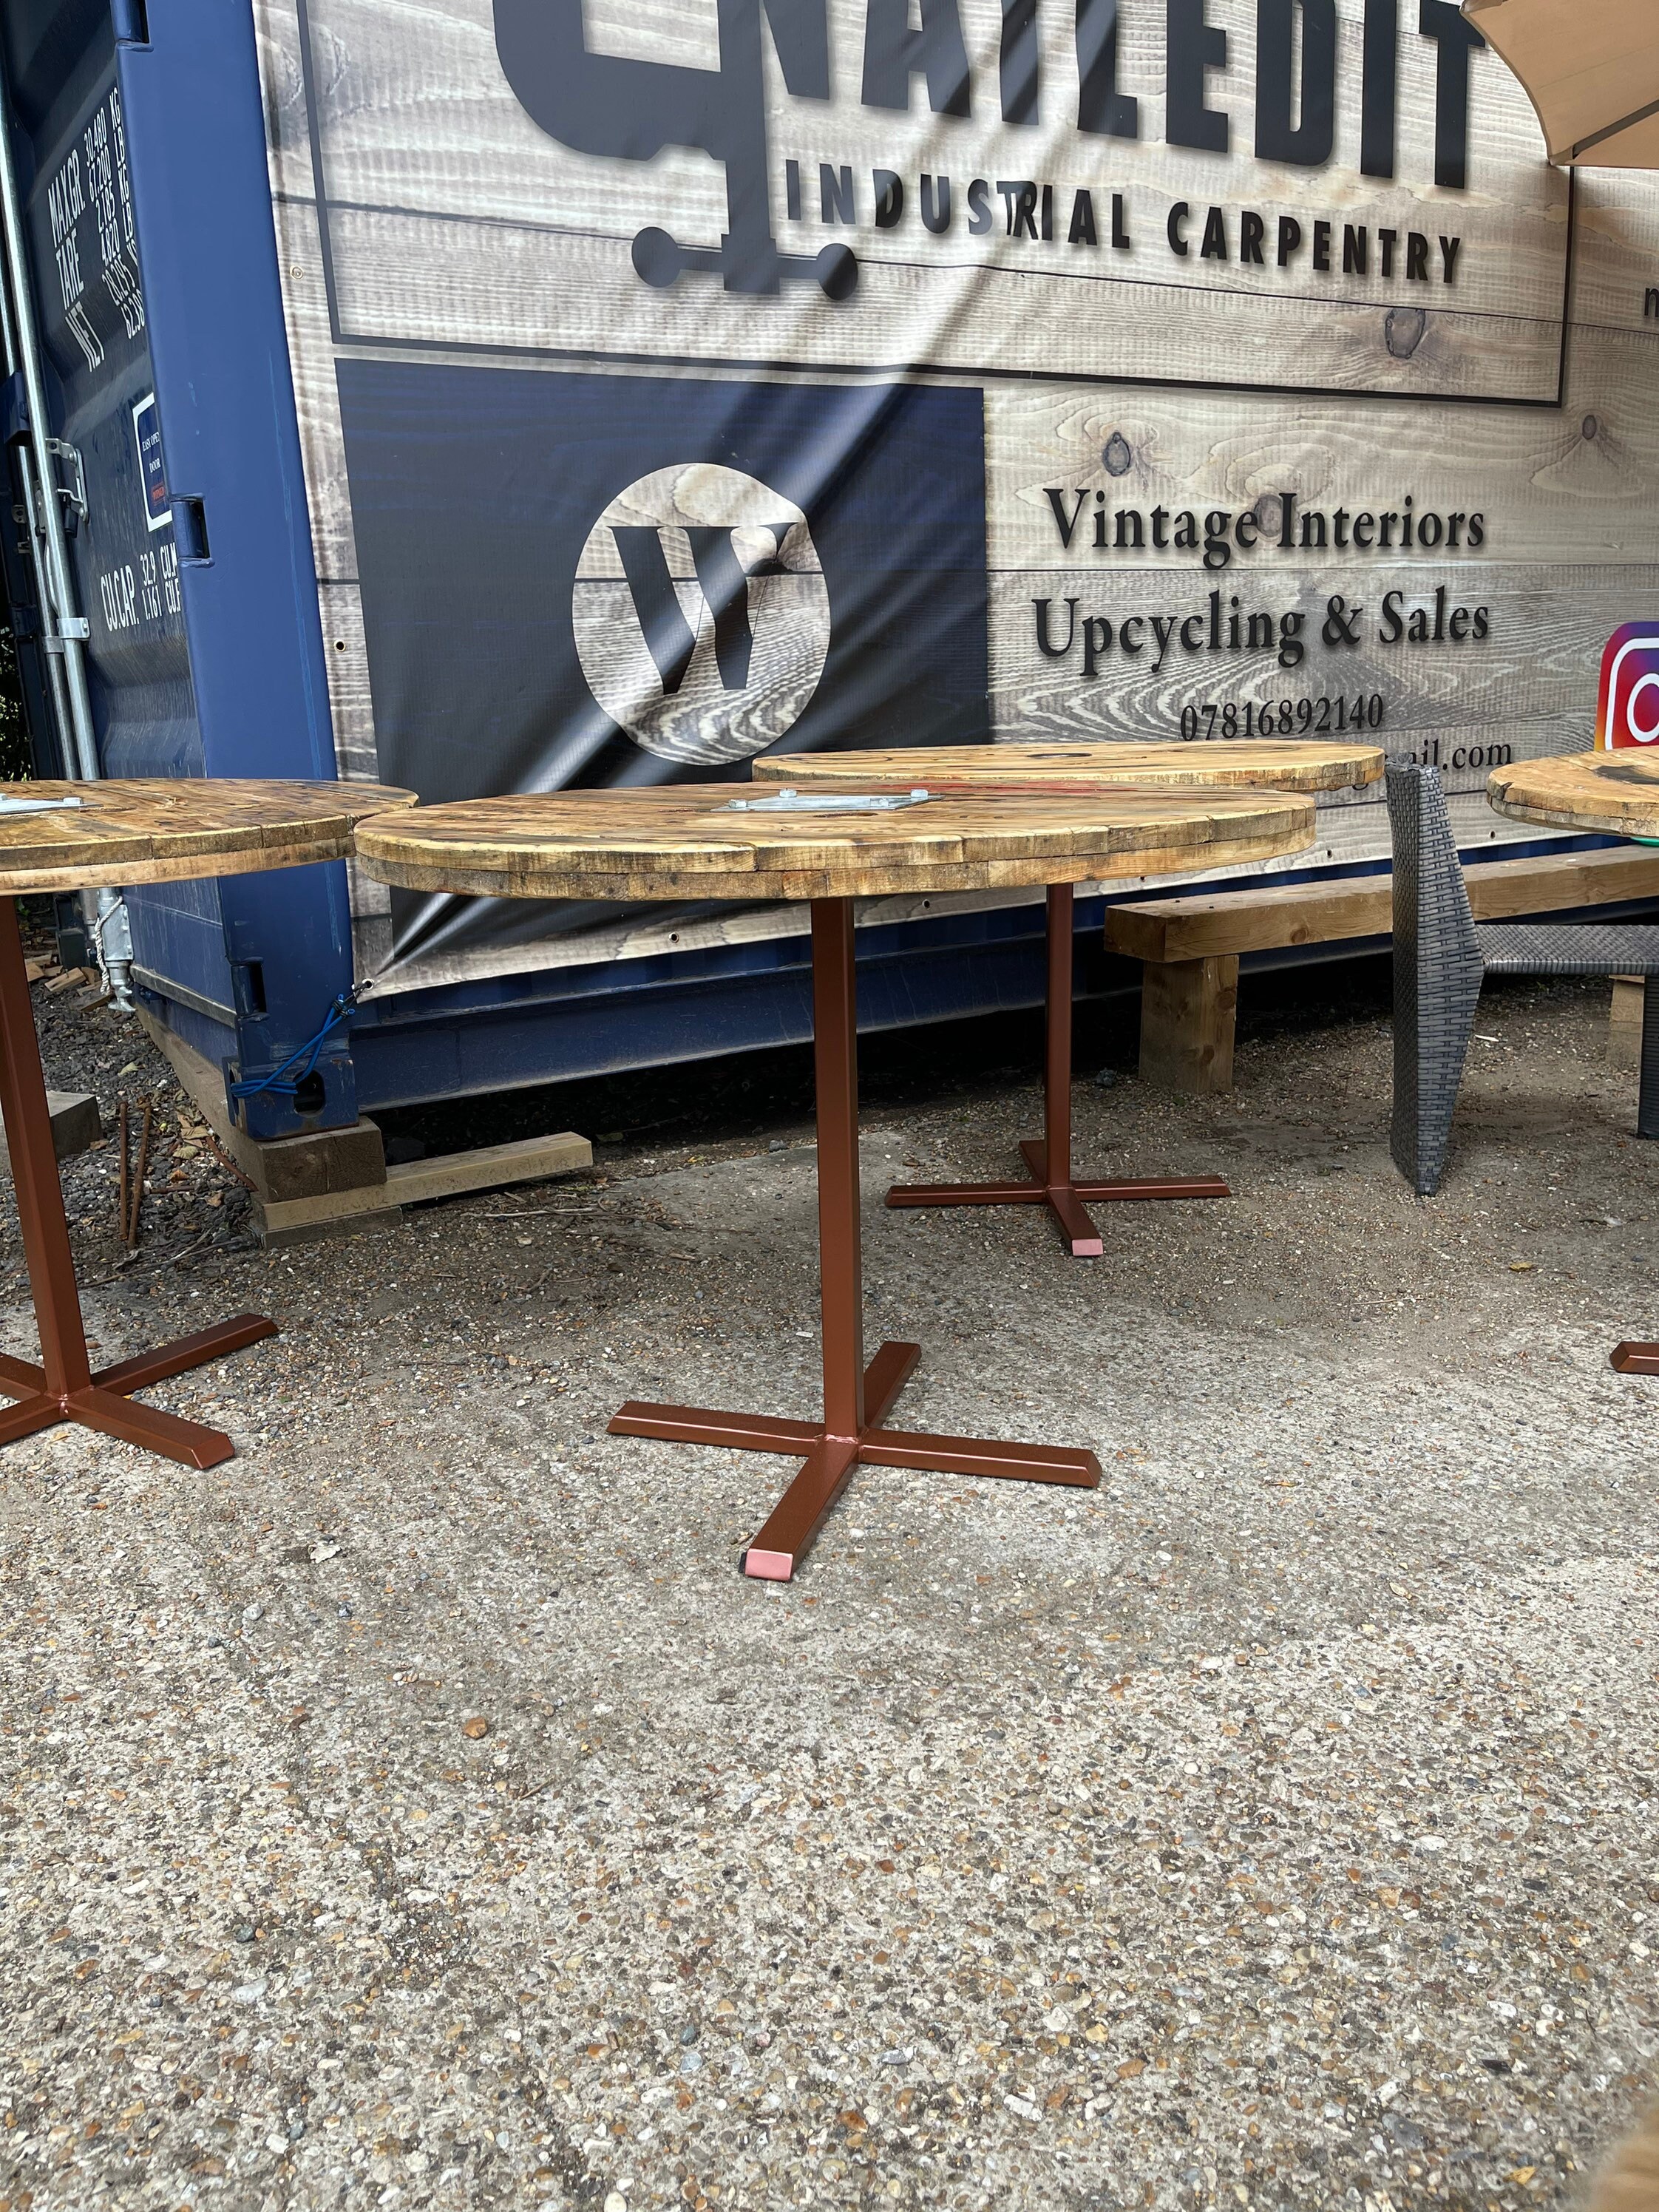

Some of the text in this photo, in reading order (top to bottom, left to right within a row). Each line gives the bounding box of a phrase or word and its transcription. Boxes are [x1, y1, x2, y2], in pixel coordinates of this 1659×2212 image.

[109, 87, 122, 131] KG
[114, 126, 126, 168] LB
[55, 228, 84, 311] TARE
[118, 163, 129, 206] KG
[122, 201, 133, 242] LB
[786, 159, 1461, 283] INDUSTRIAL CARPENTRY
[65, 301, 105, 373] NET
[121, 288, 145, 339] 62.38
[149, 458, 161, 474] DOOR
[1042, 488, 1485, 569] Vintage Interiors
[605, 522, 799, 696] W
[1031, 585, 1489, 676] Upcycling & Sales
[1180, 693, 1383, 741] 07816892140
